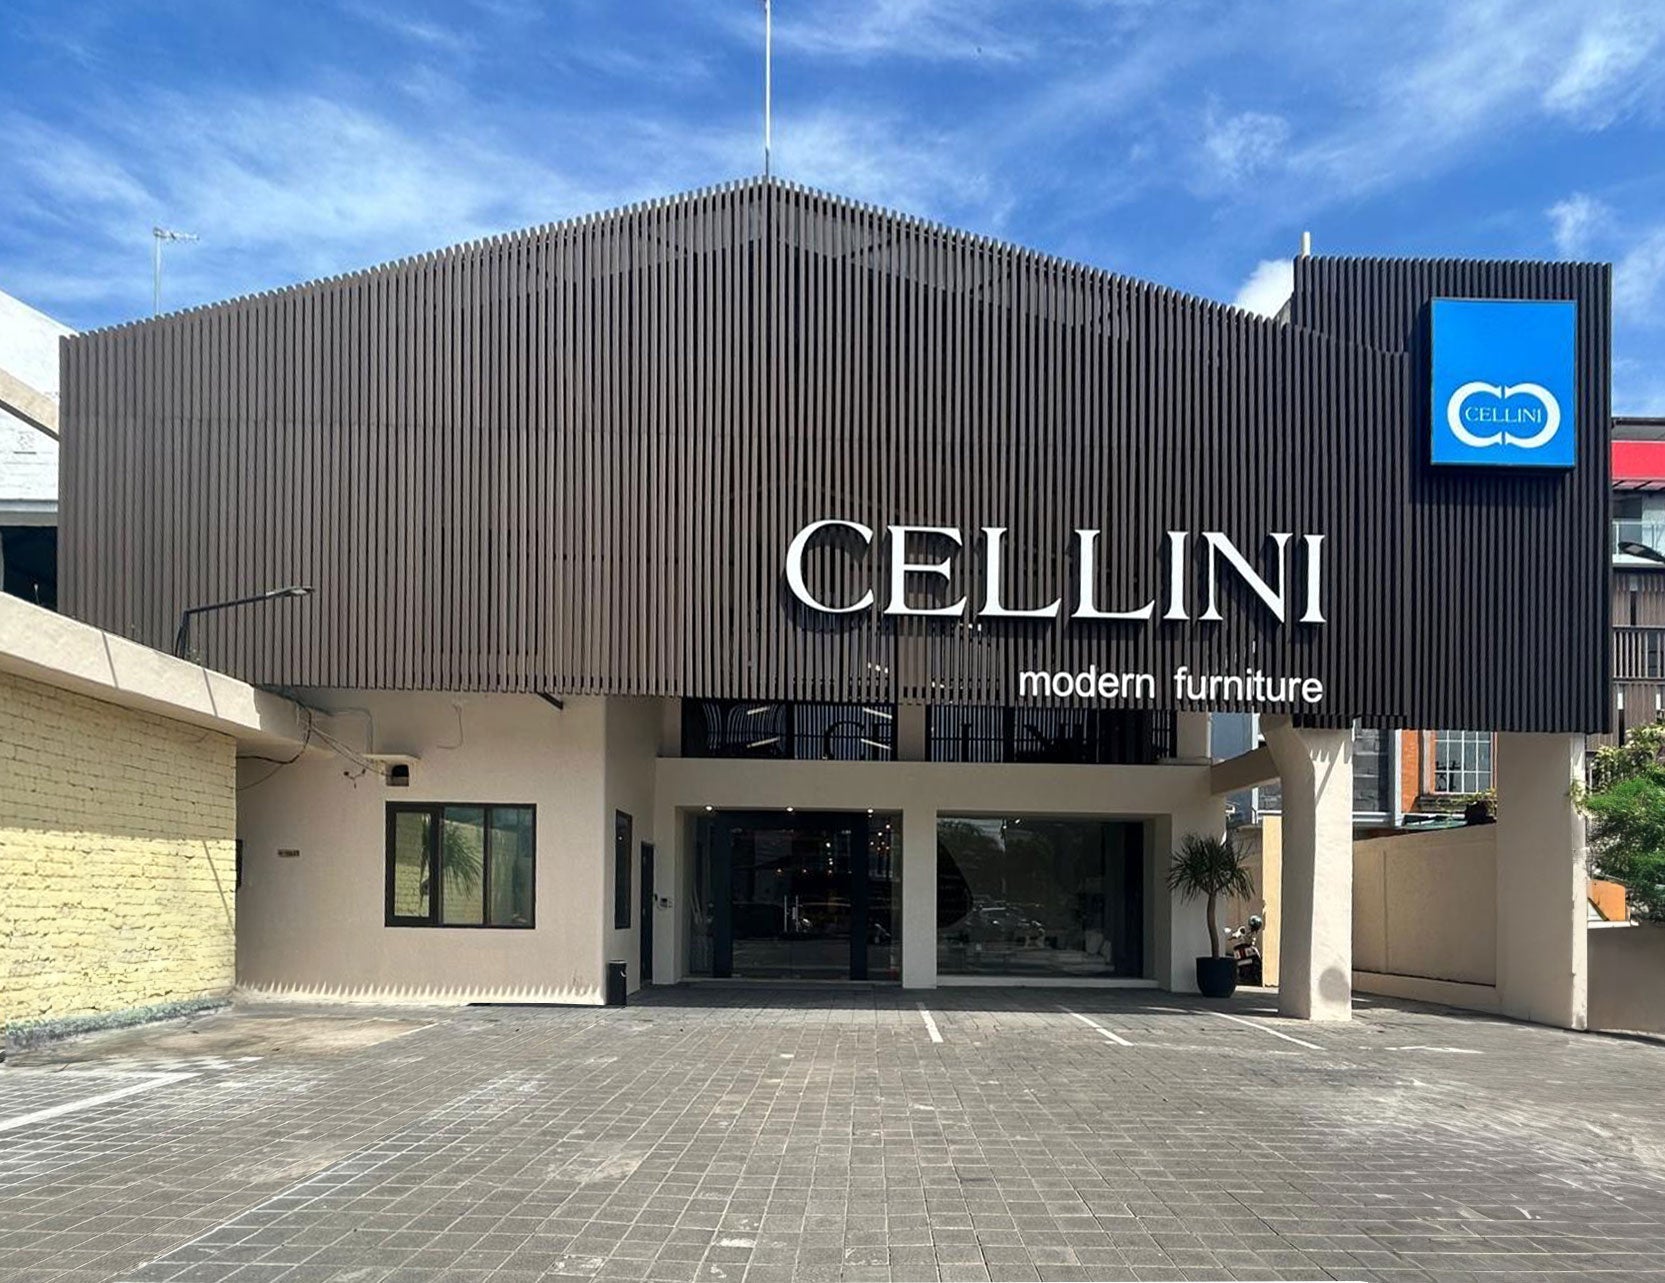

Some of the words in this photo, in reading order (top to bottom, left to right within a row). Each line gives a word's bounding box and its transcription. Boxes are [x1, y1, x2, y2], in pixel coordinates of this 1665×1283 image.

[1465, 406, 1542, 424] CELLINI
[786, 519, 1328, 624] CELLINI
[1019, 664, 1155, 699] modern
[1173, 666, 1323, 704] furniture
